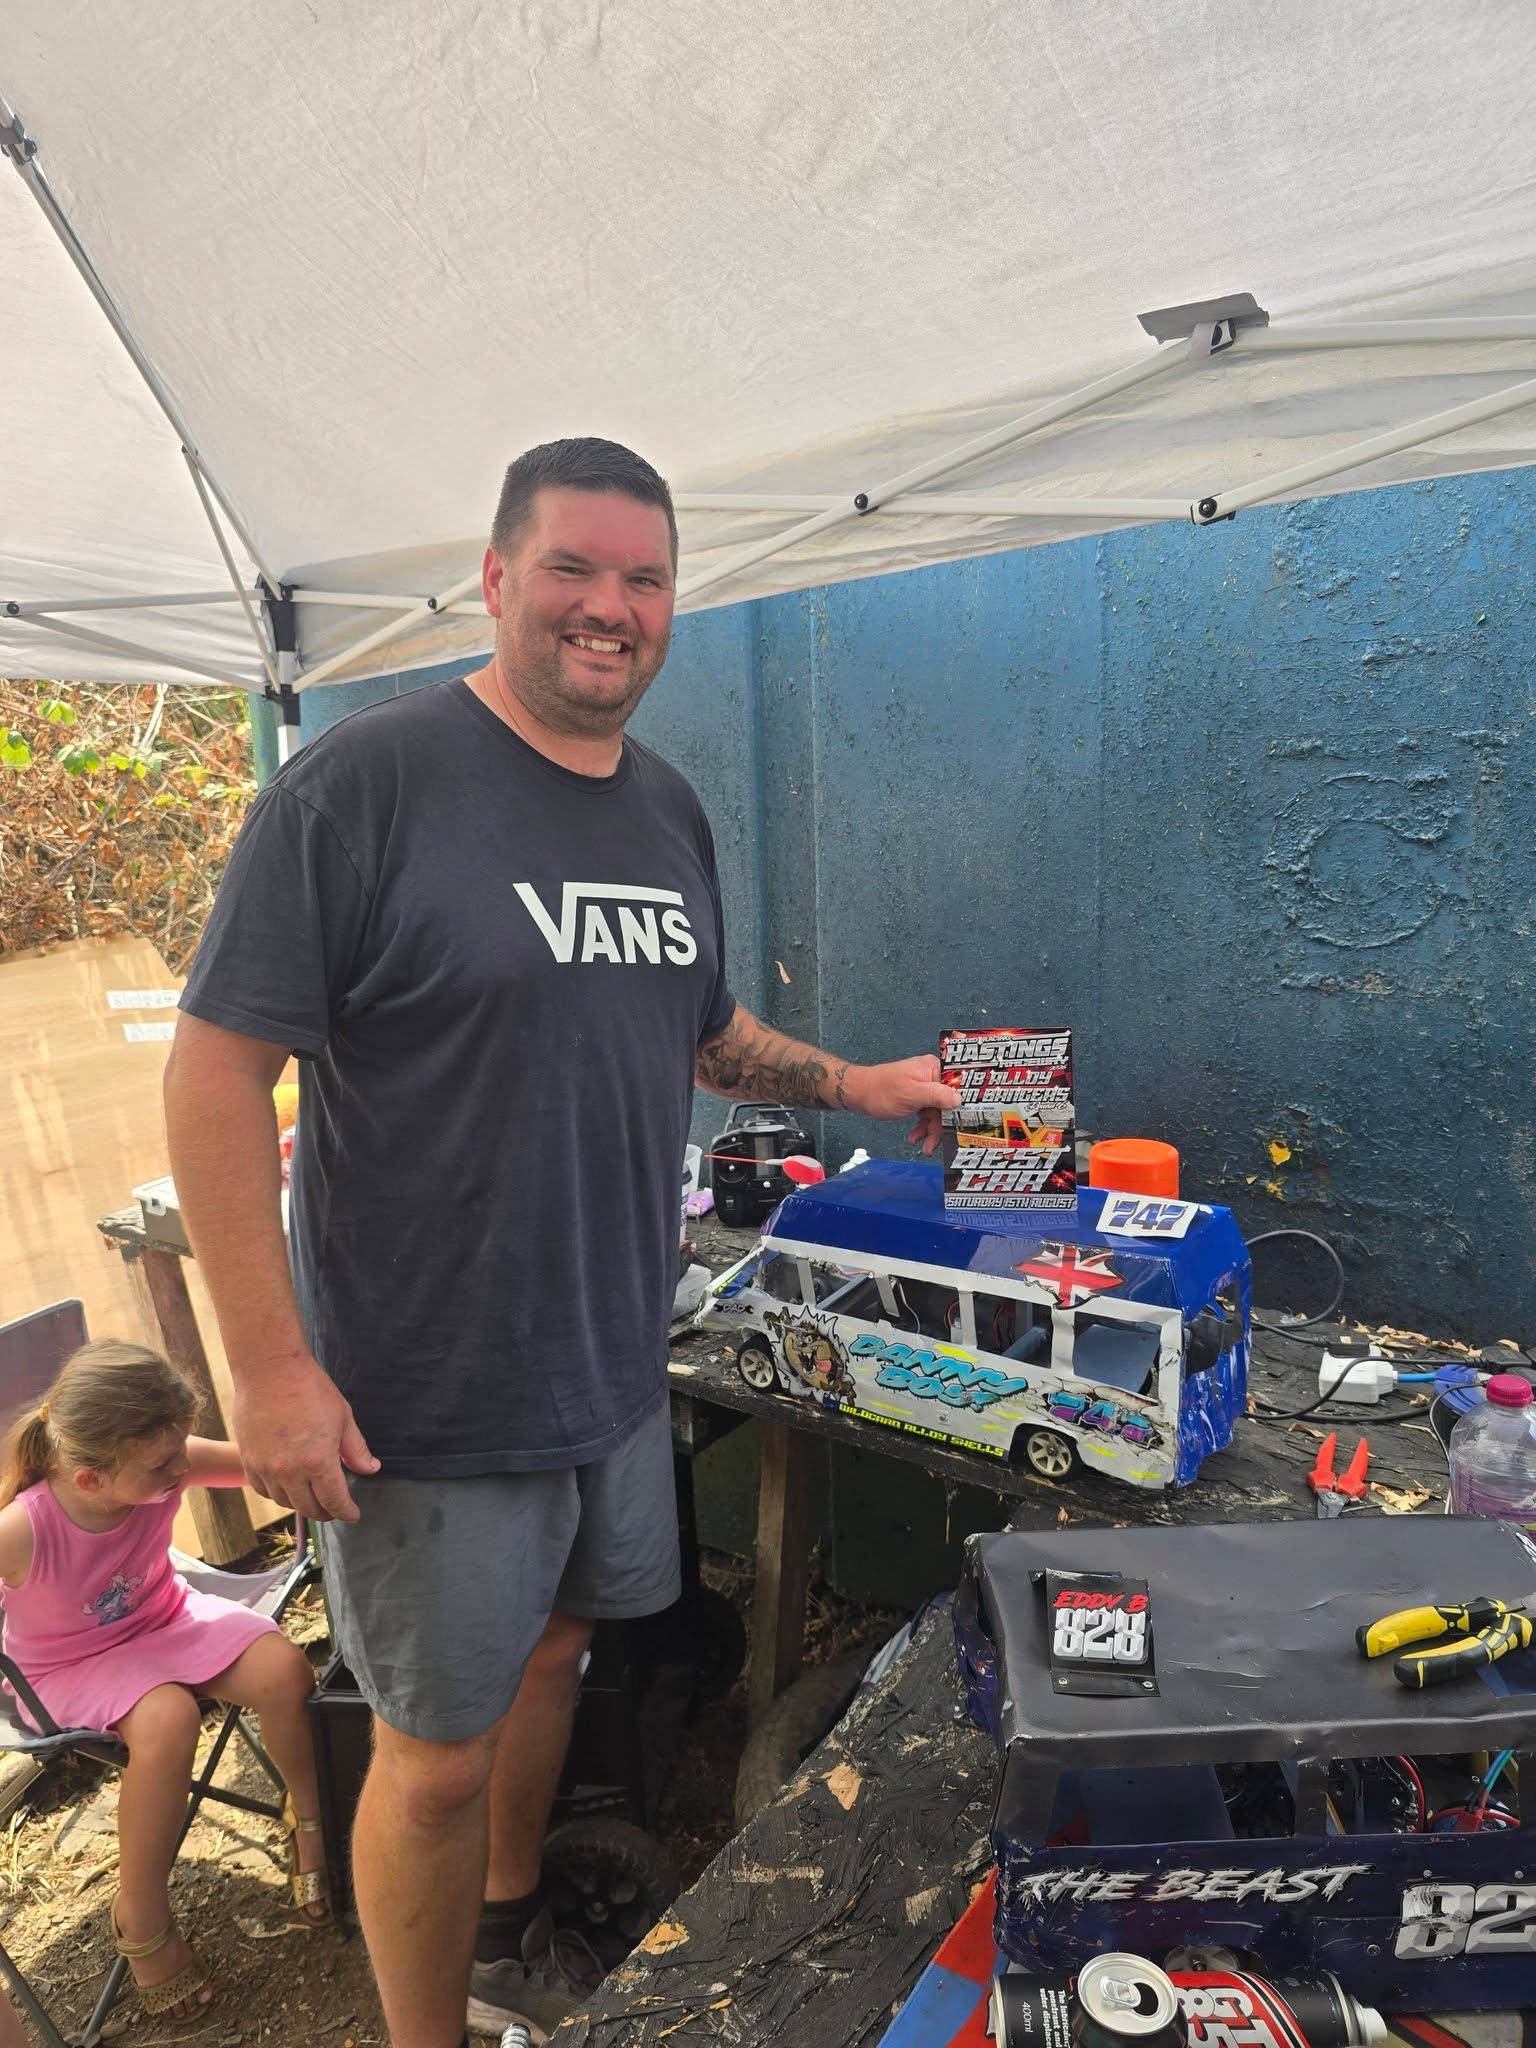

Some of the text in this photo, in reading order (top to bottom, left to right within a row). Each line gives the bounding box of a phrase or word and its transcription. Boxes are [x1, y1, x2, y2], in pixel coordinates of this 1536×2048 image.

[512, 881, 698, 966] VANS
[945, 1038, 1069, 1063] HASTINGS
[999, 1055, 1069, 1069] RACEWAY
[988, 1069, 1053, 1086] ALLOY
[960, 1085, 1071, 1103] AN BANGERS
[950, 1145, 1072, 1169] BEST
[955, 1169, 1053, 1192] CAR
[946, 1196, 1075, 1208] SATURDAY 15TH AUGUST
[722, 1304, 746, 1313] DAD
[848, 1334, 1029, 1398] DANNY
[839, 1403, 1005, 1457] WILDCARD ALLOY SHELLS
[1053, 1590, 1149, 1614] EDDY B
[1053, 1606, 1148, 1662] 828
[1017, 1863, 1376, 1909] THE BEAST
[1039, 1988, 1049, 2009] water
[1057, 1990, 1066, 2004] The
[1022, 2001, 1034, 2033] 400ml
[1048, 1990, 1063, 2048] penetrant and
